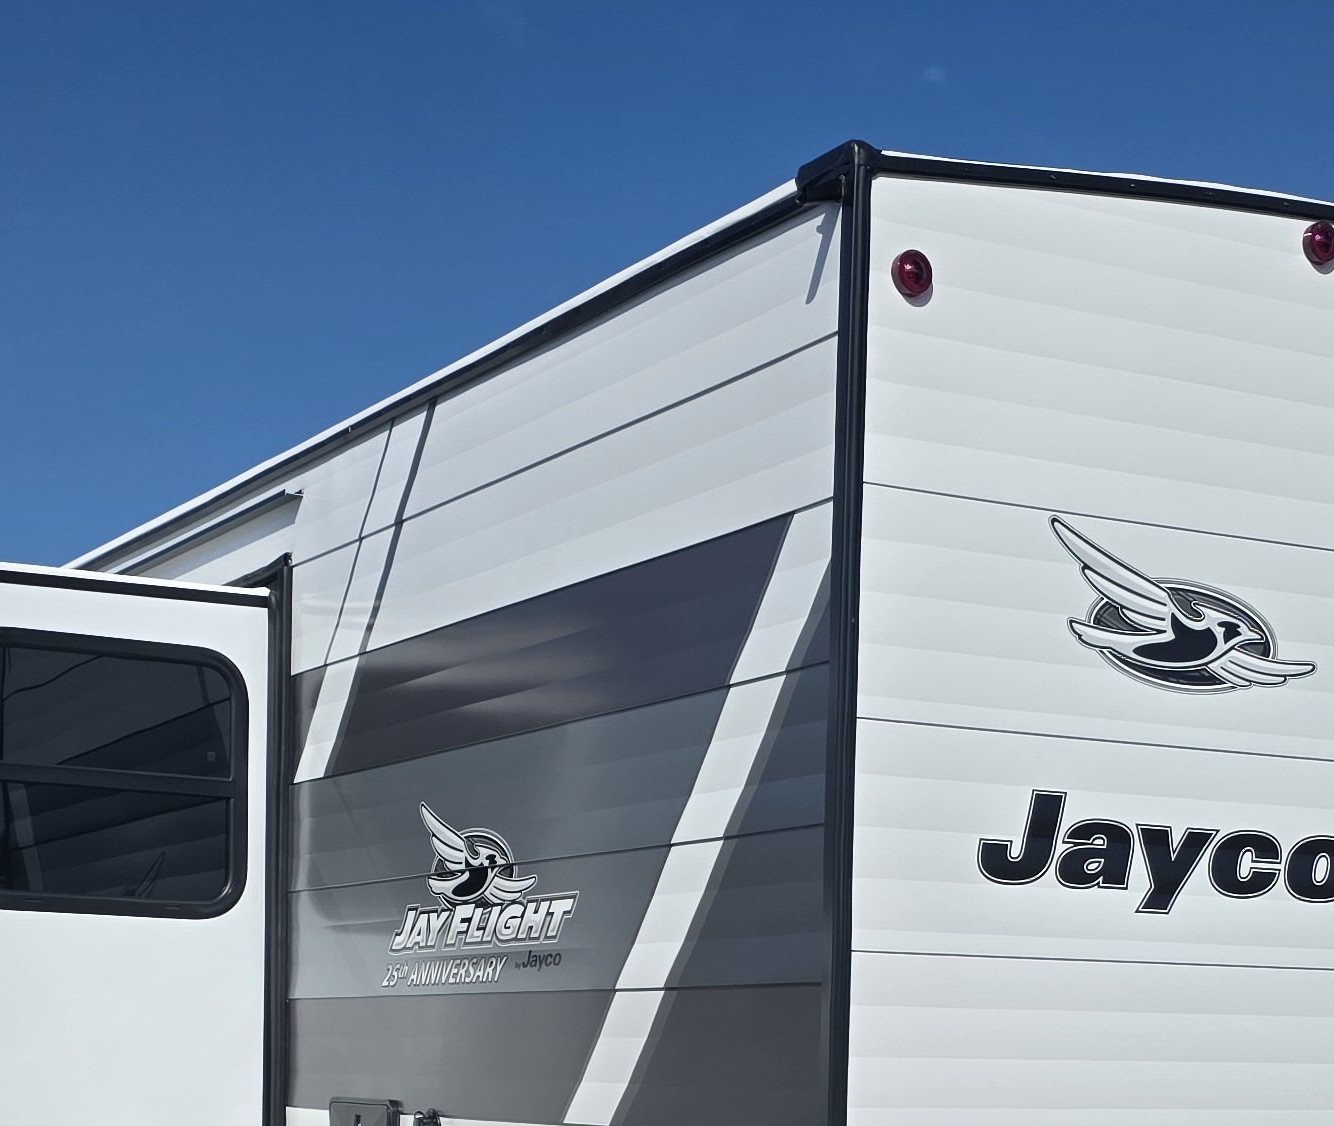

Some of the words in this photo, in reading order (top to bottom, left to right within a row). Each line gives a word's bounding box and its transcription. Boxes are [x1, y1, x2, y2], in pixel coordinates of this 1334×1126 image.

[391, 909, 451, 950] JAY
[446, 898, 575, 945] FLIGHT
[407, 956, 508, 986] ANNIVERSARY
[522, 950, 562, 971] Jayco
